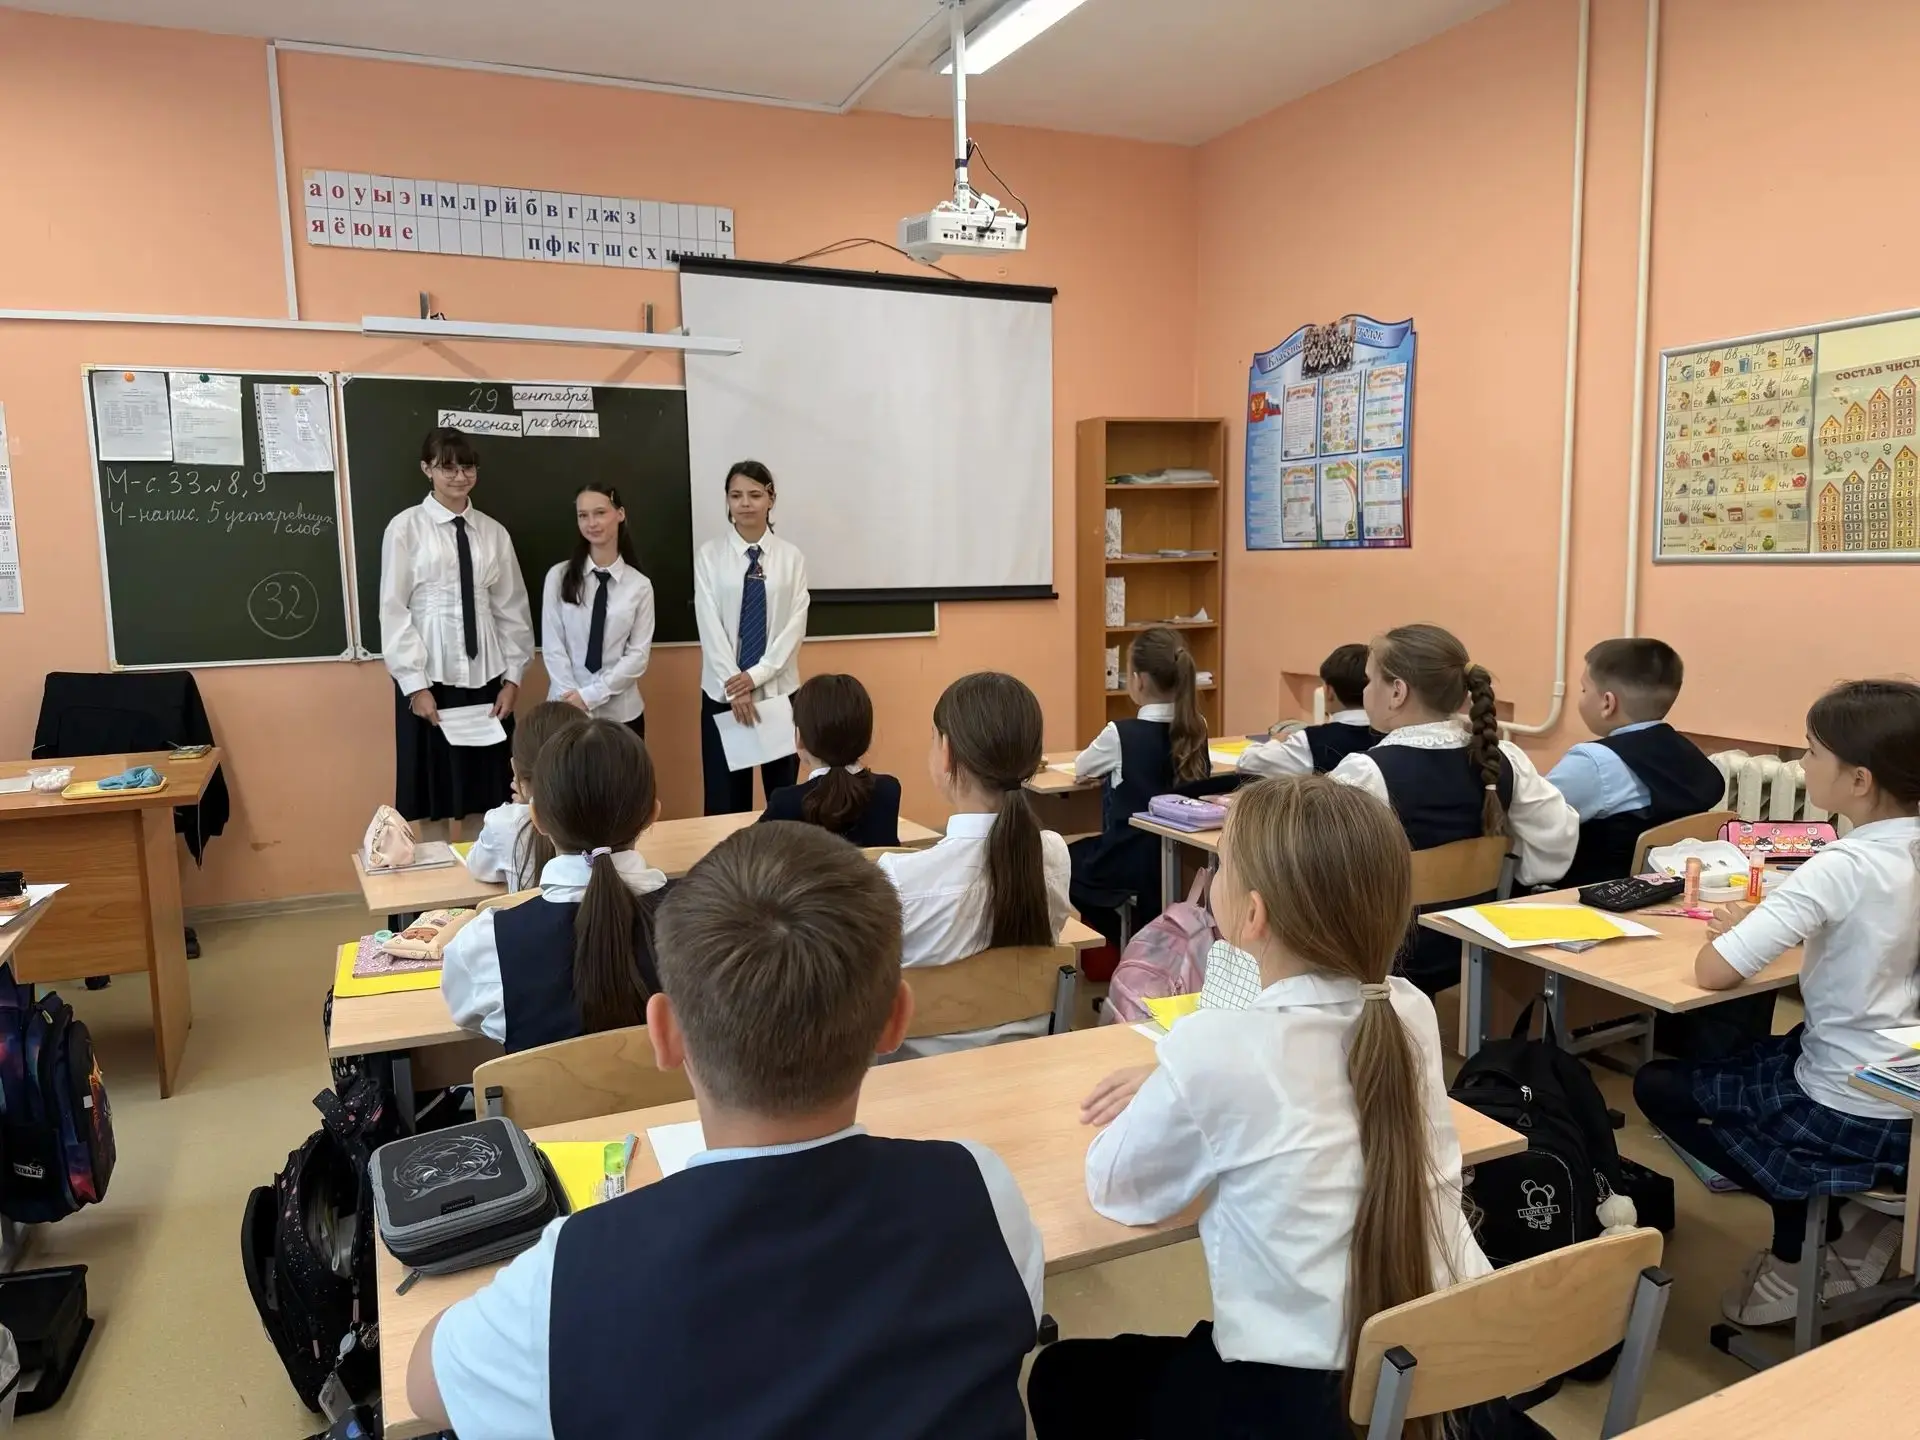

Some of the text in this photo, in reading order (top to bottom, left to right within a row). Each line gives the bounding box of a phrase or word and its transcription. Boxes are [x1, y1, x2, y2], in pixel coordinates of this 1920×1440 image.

[310, 184, 731, 232] а о у ы э н м л р й б в г д ж з ъ
[312, 217, 656, 259] я ё ю и е п ф к т ш с х
[1836, 366, 1882, 380] СОСТАВ
[469, 388, 498, 412] 29
[440, 413, 520, 432] Классная
[169, 471, 201, 494] 33
[208, 501, 224, 523] 5
[265, 582, 304, 621] 32
